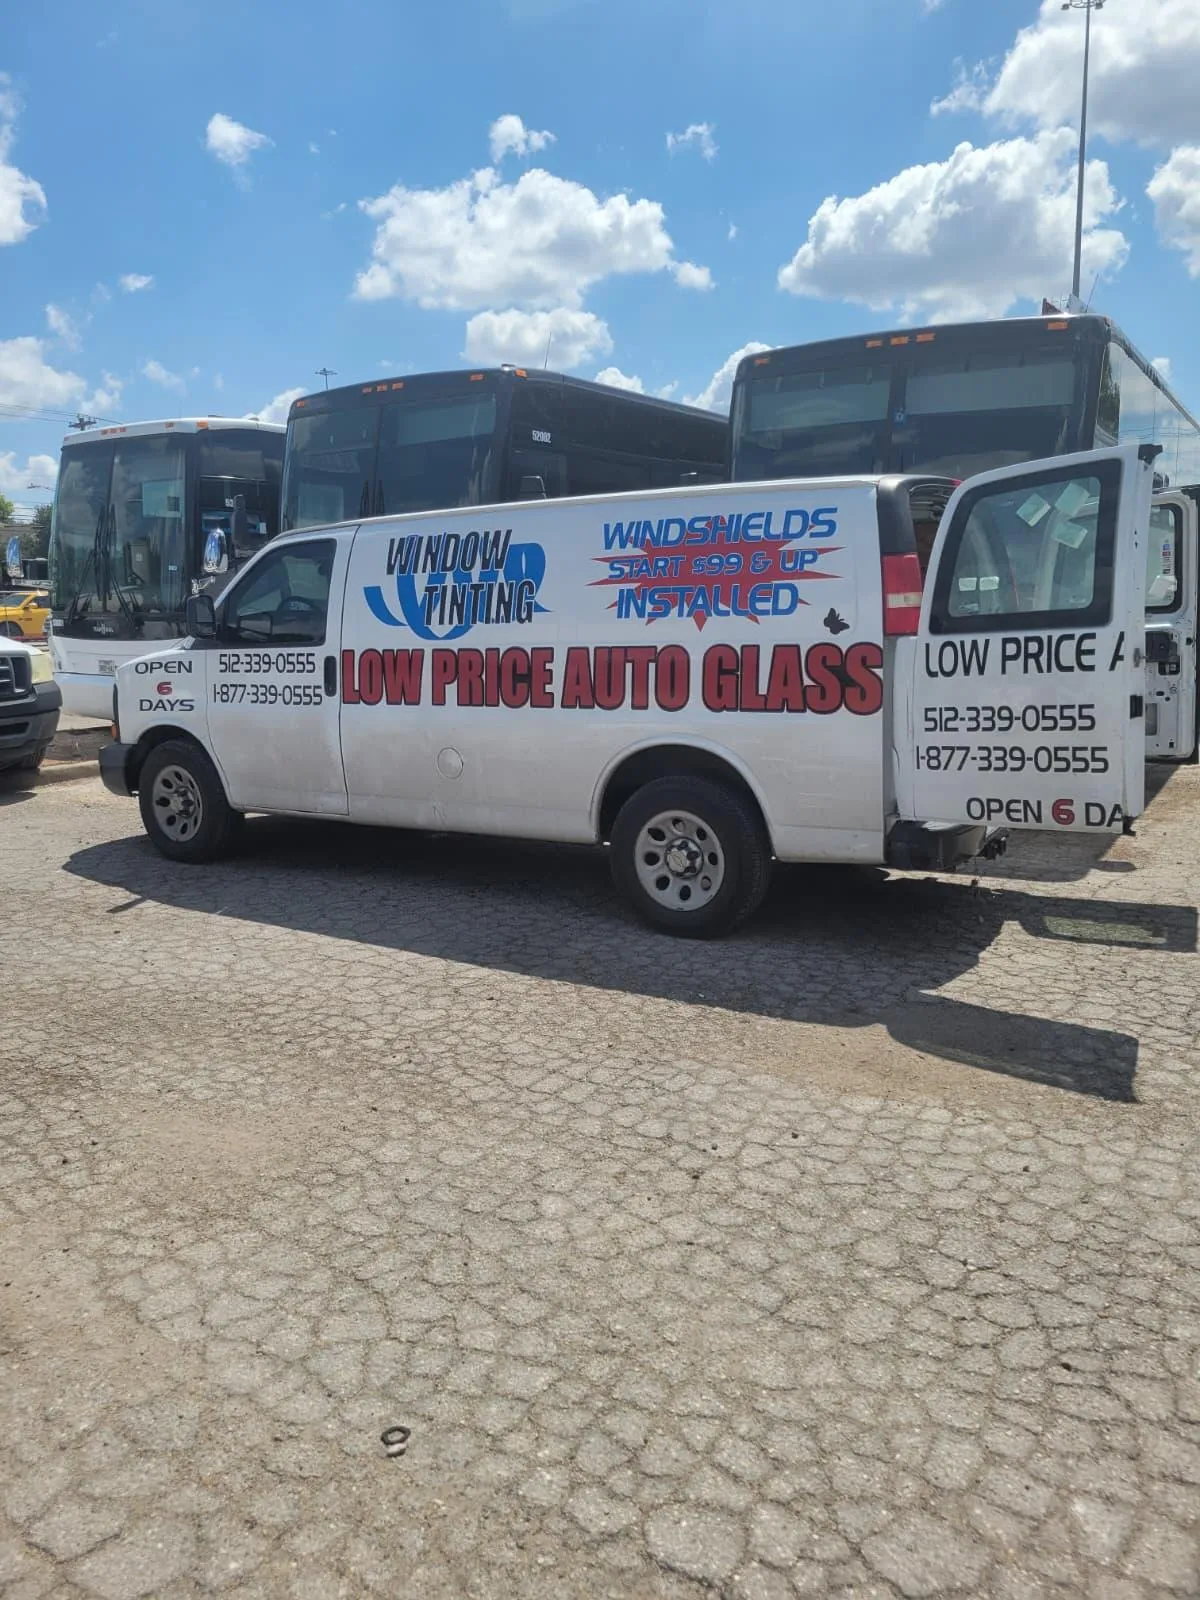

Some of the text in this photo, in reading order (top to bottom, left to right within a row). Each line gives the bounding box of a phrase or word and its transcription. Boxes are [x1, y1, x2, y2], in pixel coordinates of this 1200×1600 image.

[603, 507, 838, 550] WINDSHIELDS
[386, 529, 513, 576] WINDOW
[608, 549, 819, 579] START $99 & UP
[424, 580, 536, 626] TINTING
[616, 582, 800, 619] INSTALLED
[135, 660, 193, 674] OPEN
[219, 653, 316, 673] 512-339-0555
[925, 638, 990, 678] LOW
[1001, 632, 1097, 675] PRICE
[156, 681, 173, 695] 6
[342, 642, 884, 716] LOW PRICE AUTO GLASS
[139, 699, 195, 712] DAYS
[213, 683, 323, 706] 1-877-339-0555
[924, 704, 1096, 732] 512-339-0555
[916, 745, 1109, 773] 1-877-339-0555
[966, 797, 1042, 824] OPEN
[1051, 798, 1076, 826] 6
